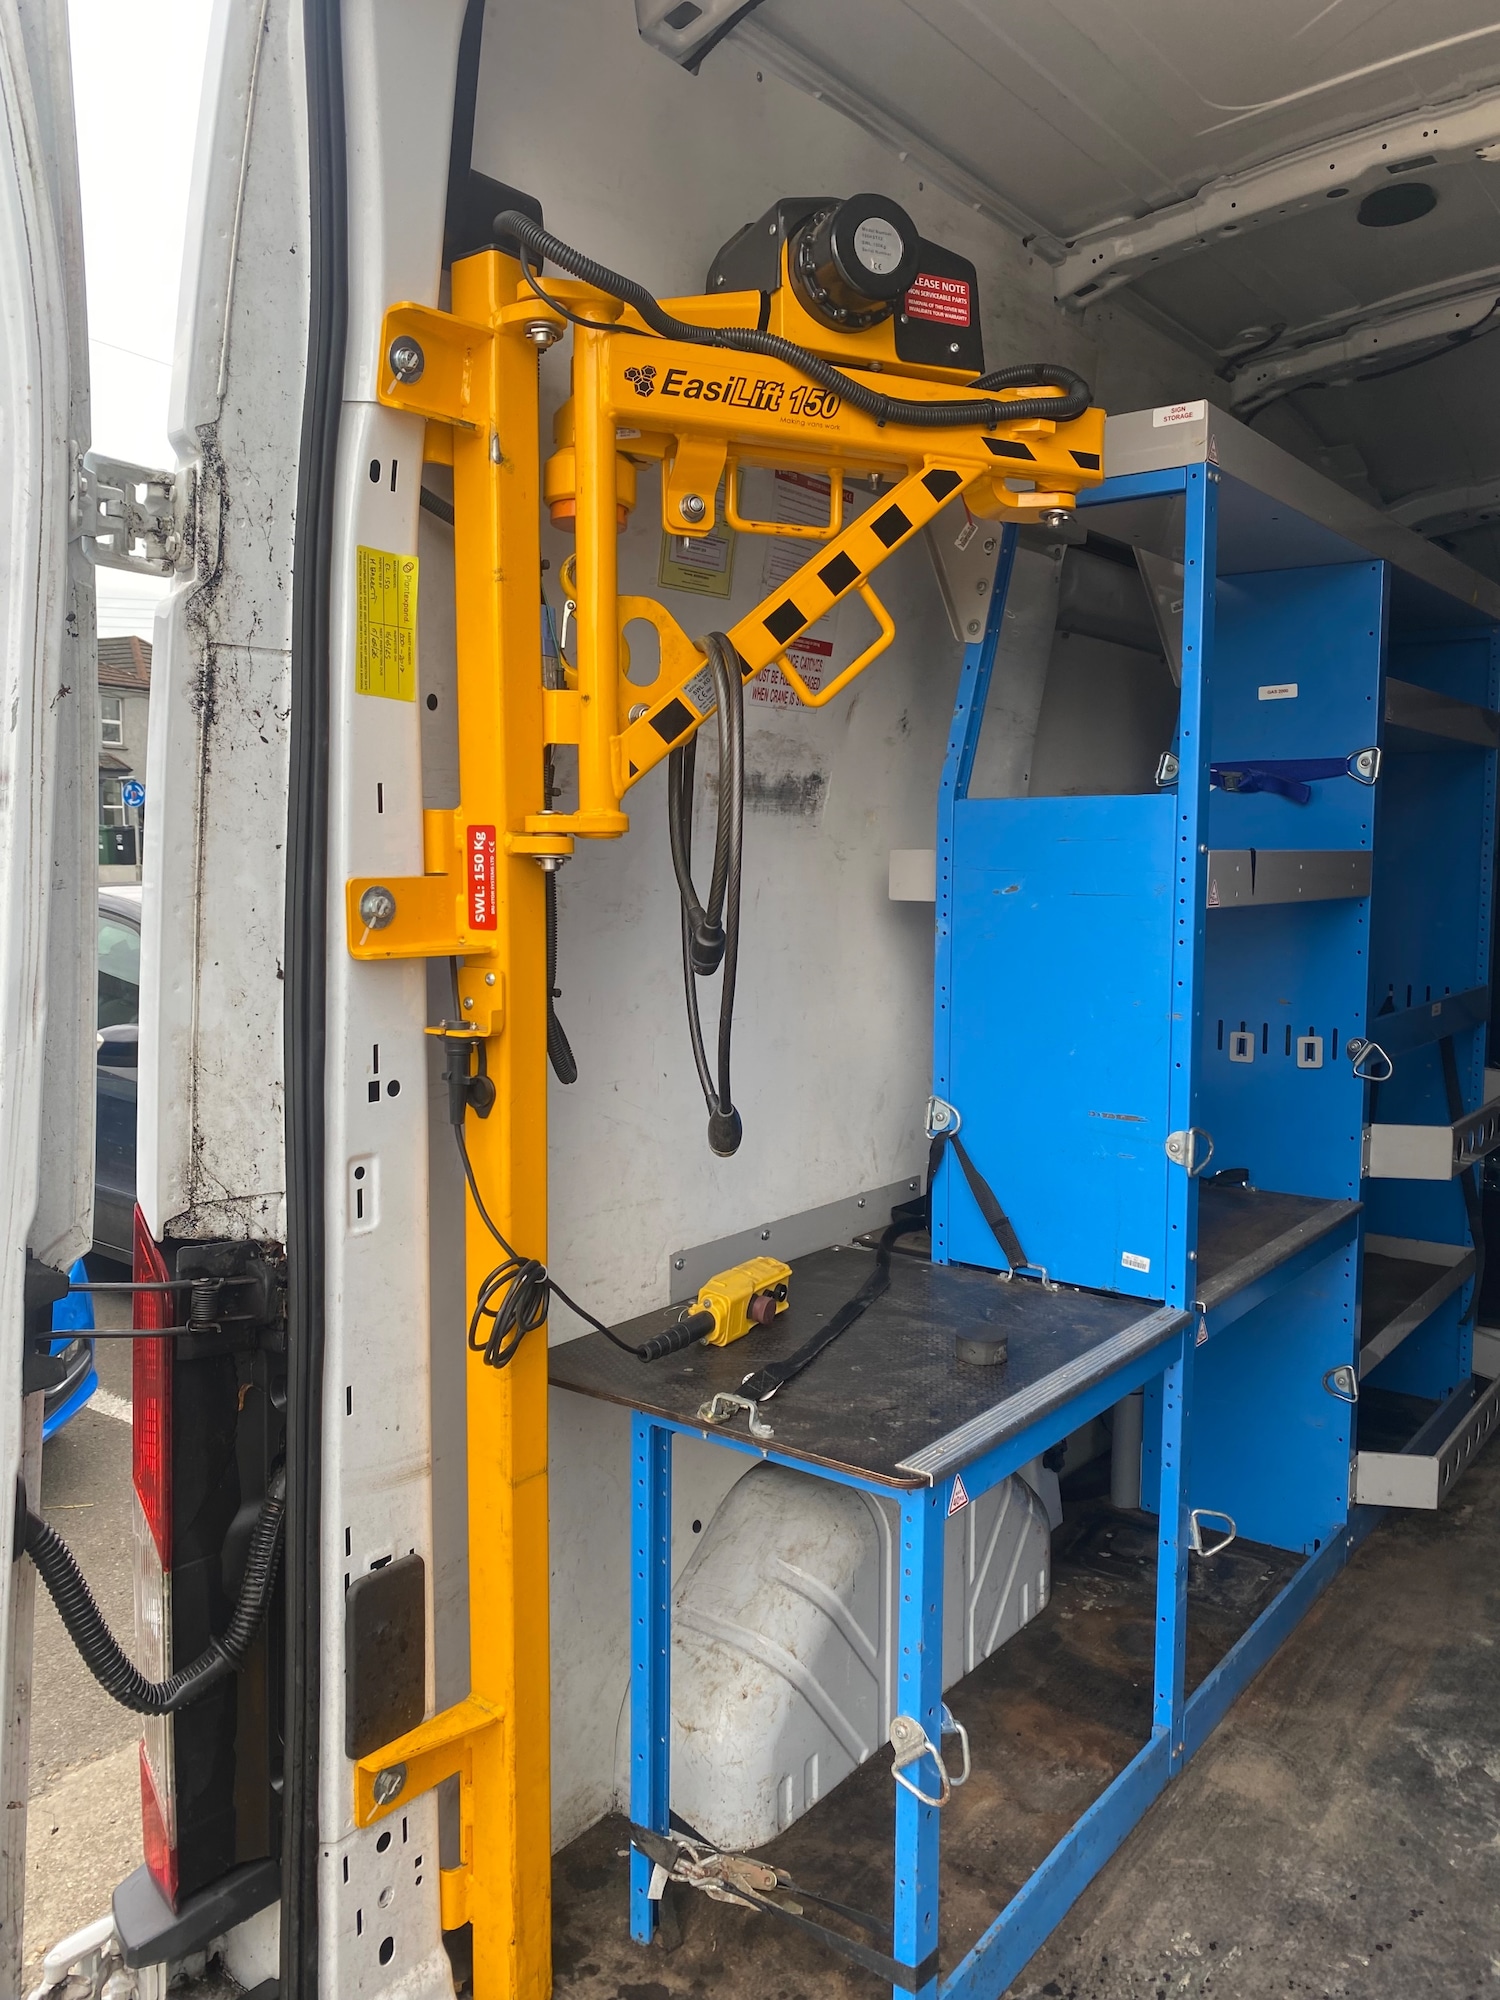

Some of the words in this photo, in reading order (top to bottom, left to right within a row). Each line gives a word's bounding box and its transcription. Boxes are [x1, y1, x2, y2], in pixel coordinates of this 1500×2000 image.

[914, 277, 940, 290] LEASE
[942, 281, 966, 295] NOTE
[908, 298, 928, 308] REMOVAL
[920, 290, 952, 302] SERVICEABLE
[952, 296, 968, 305] PARTS
[908, 306, 932, 316] INVALIDATE
[932, 310, 945, 318] YOUR
[944, 312, 968, 321] WARRANTY
[660, 368, 785, 412] EasiLift
[790, 386, 842, 420] 150
[1163, 412, 1194, 422] STORAGE
[1171, 406, 1186, 414] SIGN
[780, 416, 806, 428] Making
[806, 420, 824, 429] vans
[824, 422, 841, 430] work
[771, 670, 780, 684] BE
[752, 686, 770, 702] WHEN
[770, 689, 789, 704] CRANE
[789, 691, 796, 706] IS
[474, 831, 486, 850] Kg
[474, 853, 485, 882] 150
[474, 885, 486, 923] SWL:
